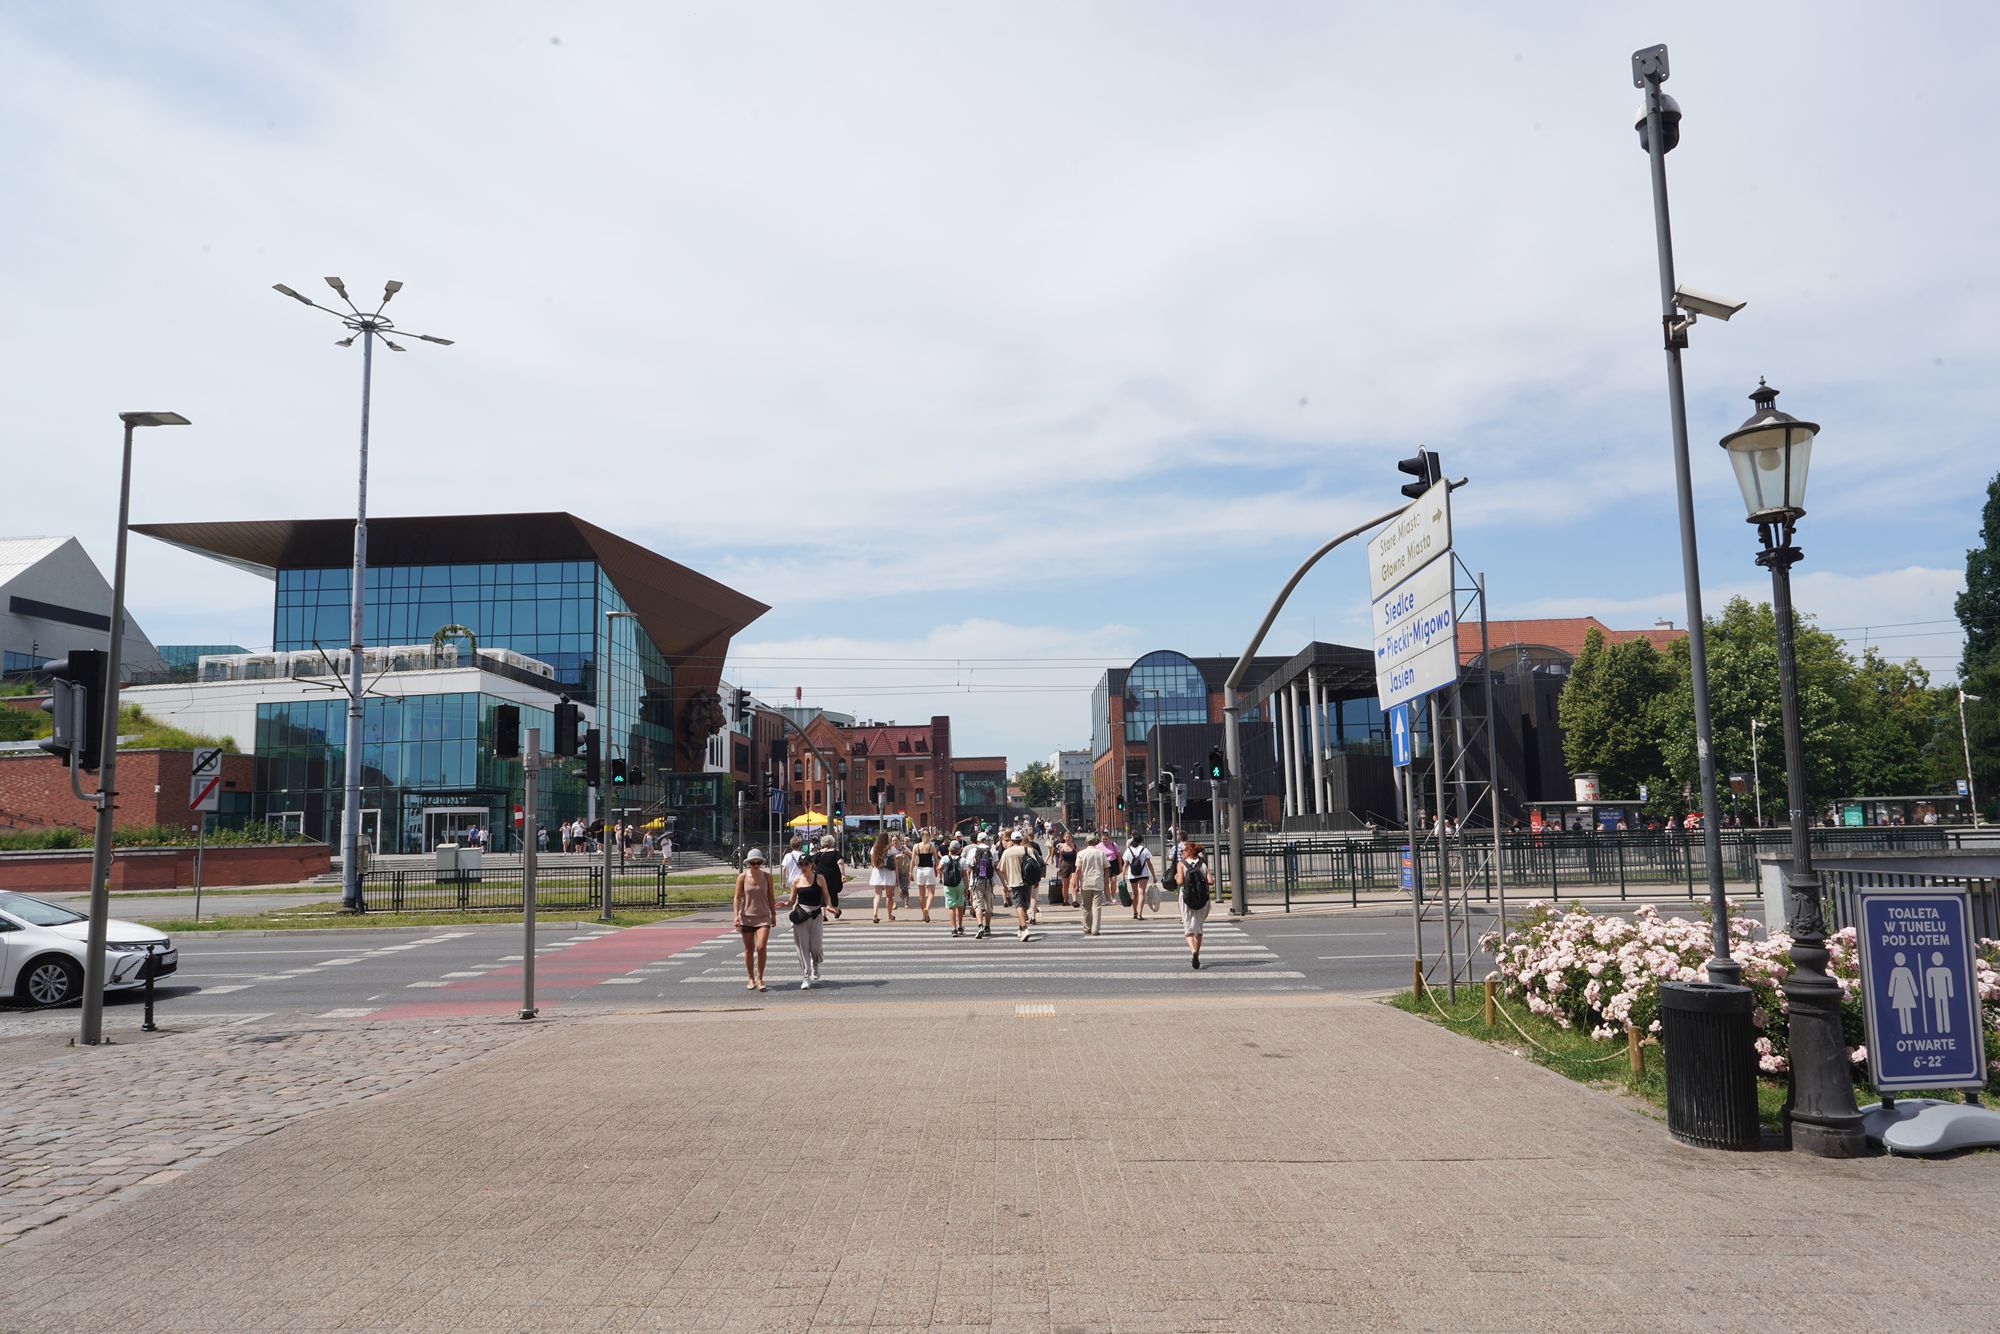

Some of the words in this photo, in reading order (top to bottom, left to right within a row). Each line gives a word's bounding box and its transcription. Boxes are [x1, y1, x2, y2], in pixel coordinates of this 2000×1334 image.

[1380, 533, 1397, 556] Stare
[1397, 512, 1421, 541] Miasto
[1407, 534, 1431, 562] Miasto
[1385, 592, 1414, 625] Siedlce
[1386, 609, 1450, 659] Piecki-Migowo
[1389, 660, 1415, 693] Jasień
[1884, 921, 1896, 933] W
[1899, 921, 1946, 932] TUNELU
[1887, 907, 1940, 919] TOALETA
[1882, 934, 1907, 946] POD
[1910, 934, 1950, 946] LOTEM
[1896, 1038, 1956, 1052] OTWARTE
